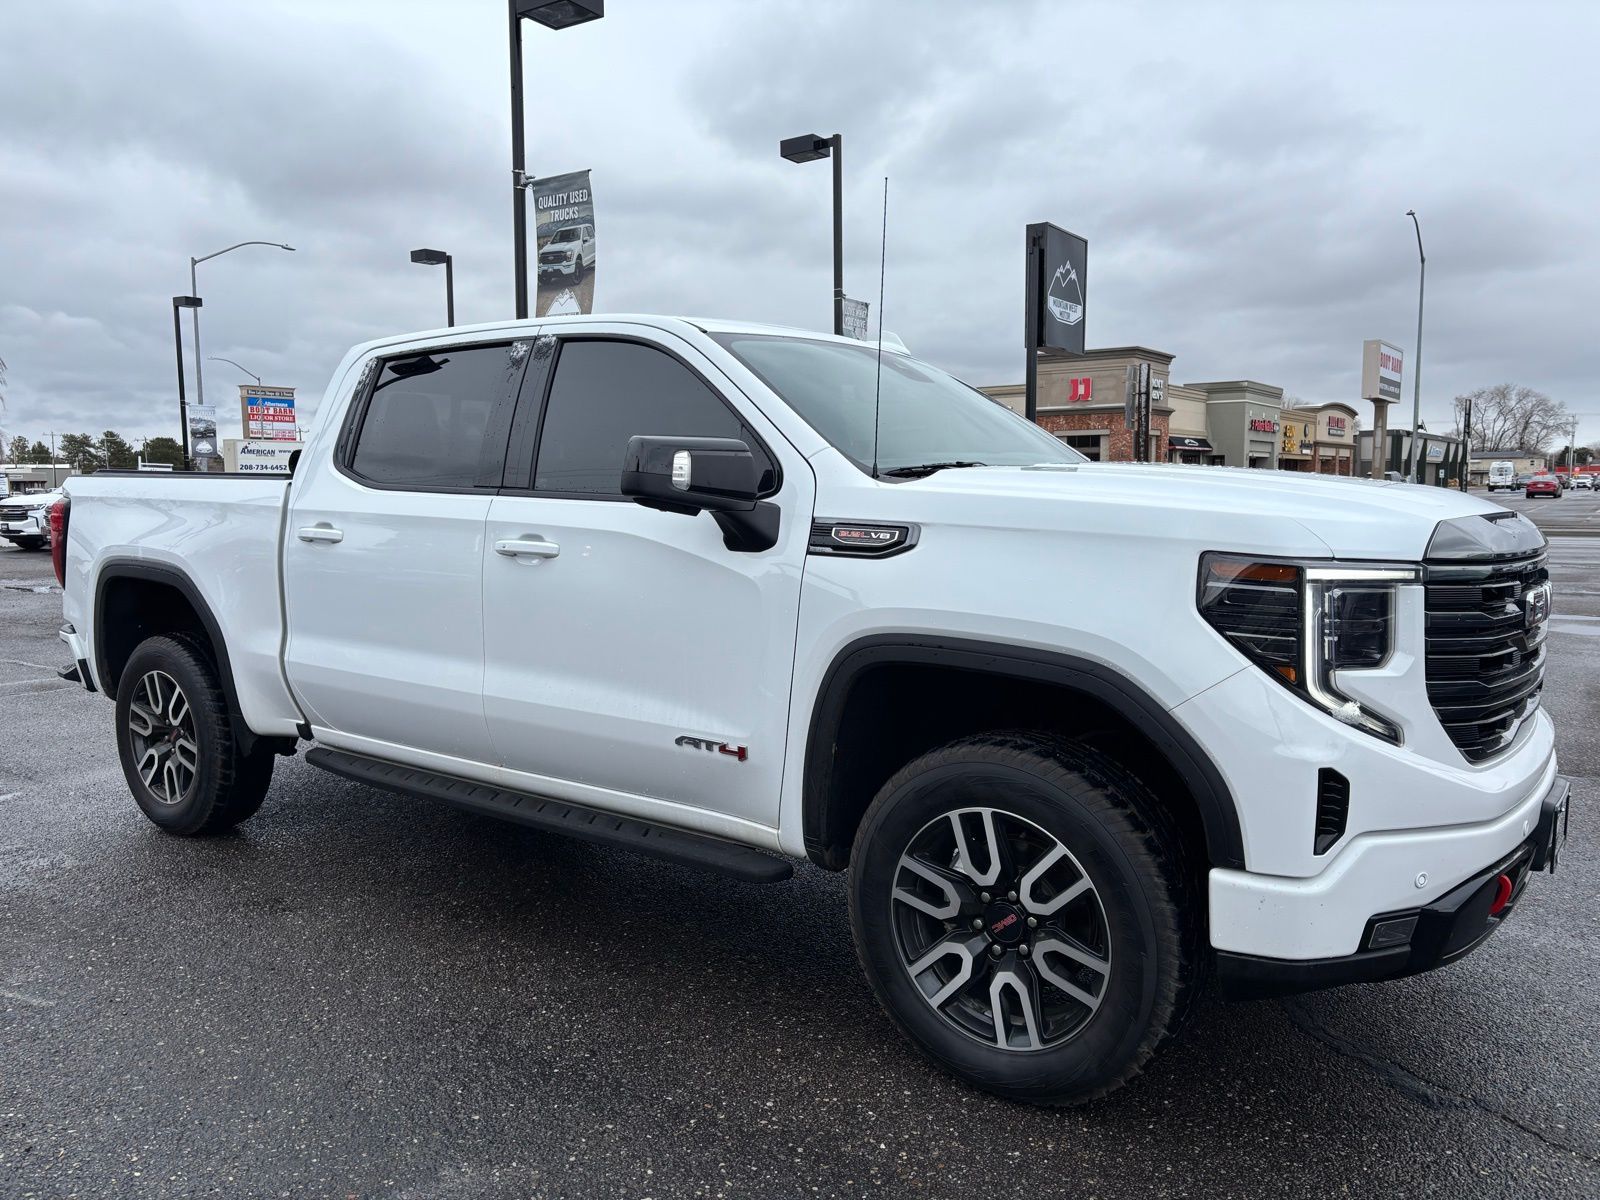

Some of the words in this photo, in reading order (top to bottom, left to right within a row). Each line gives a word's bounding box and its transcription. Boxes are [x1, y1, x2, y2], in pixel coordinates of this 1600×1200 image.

[538, 192, 568, 209] QUALITY
[569, 189, 588, 204] USED
[550, 206, 579, 222] TRUCKS
[273, 407, 293, 415] BARN
[240, 447, 276, 455] AMERICAN
[870, 532, 891, 540] V8
[674, 735, 748, 762] AT4
